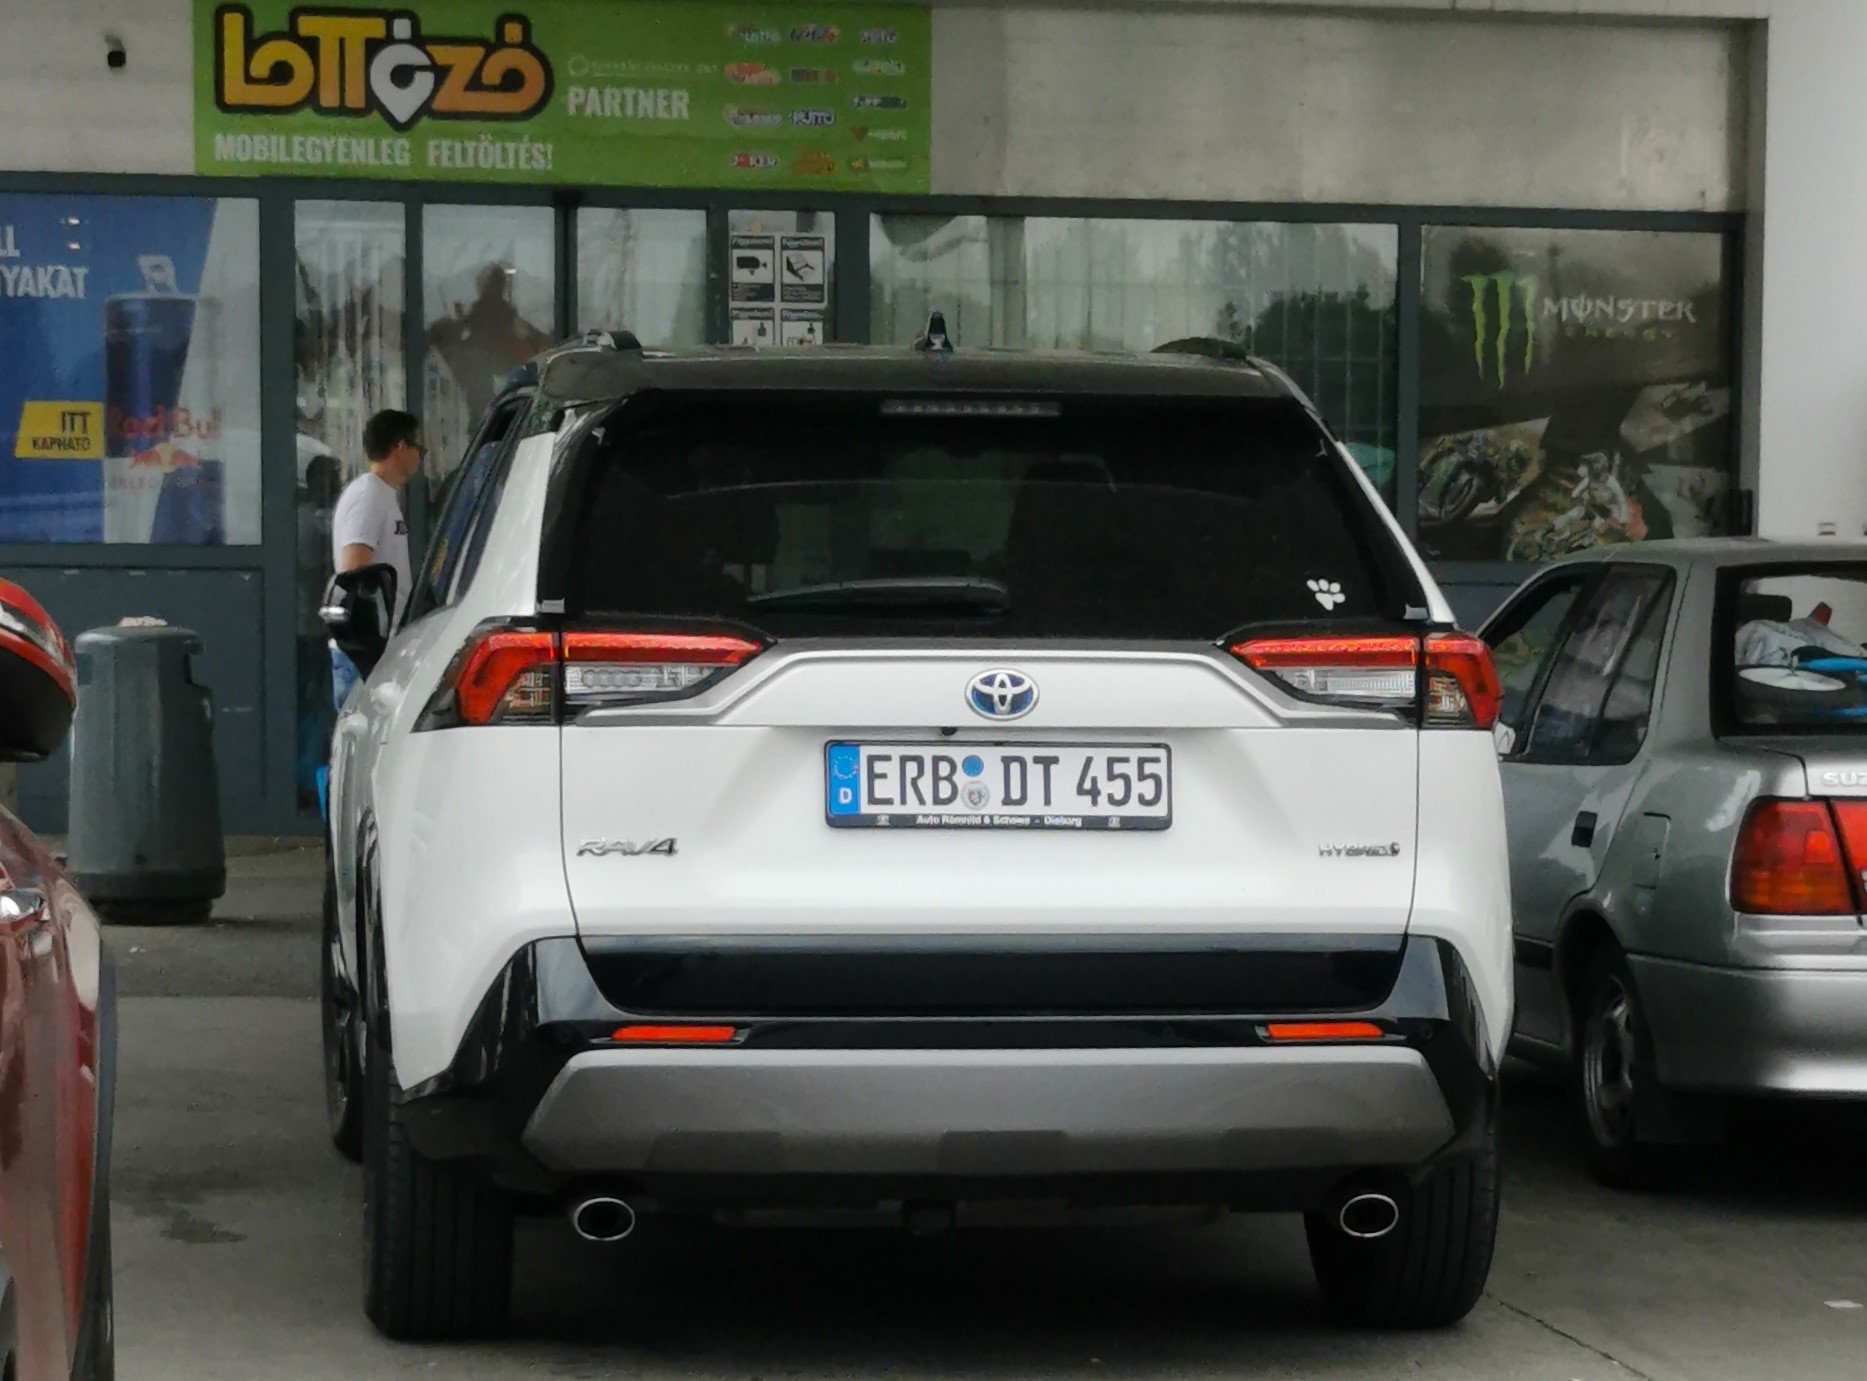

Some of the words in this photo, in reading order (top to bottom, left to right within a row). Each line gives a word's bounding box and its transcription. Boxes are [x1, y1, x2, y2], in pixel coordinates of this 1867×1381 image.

[567, 86, 690, 120] PARTNER
[214, 133, 411, 167] MOBILEGYENLEG
[0, 225, 22, 258] L
[1541, 293, 1697, 324] MONSTER
[60, 411, 92, 434] ITT
[838, 787, 853, 803] D
[866, 754, 959, 806] ERB
[1000, 755, 1060, 807] DT
[1075, 755, 1163, 808] 455
[576, 837, 679, 857] RAV4
